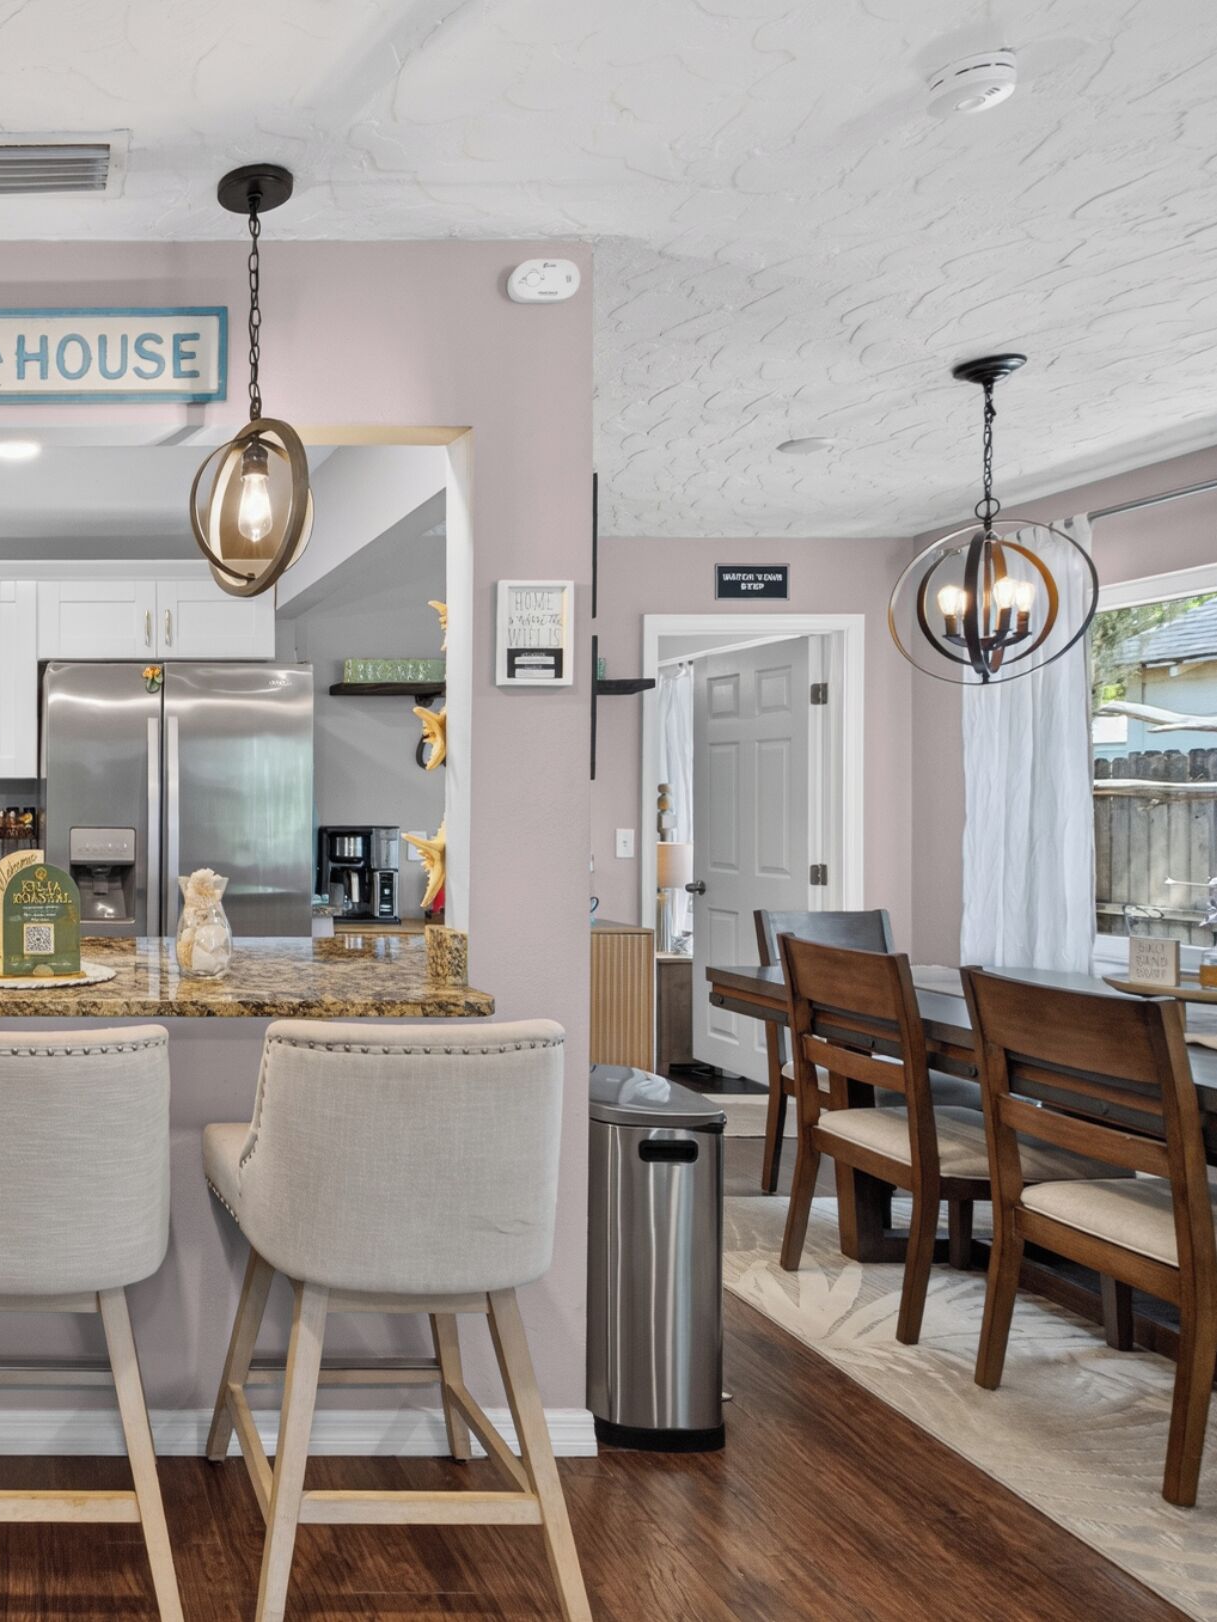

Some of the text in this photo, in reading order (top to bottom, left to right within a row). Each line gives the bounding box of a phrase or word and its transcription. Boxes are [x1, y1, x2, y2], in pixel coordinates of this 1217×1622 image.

[15, 332, 200, 380] HOUSE
[722, 573, 783, 581] WATCH YOUR
[514, 591, 553, 611] HOME
